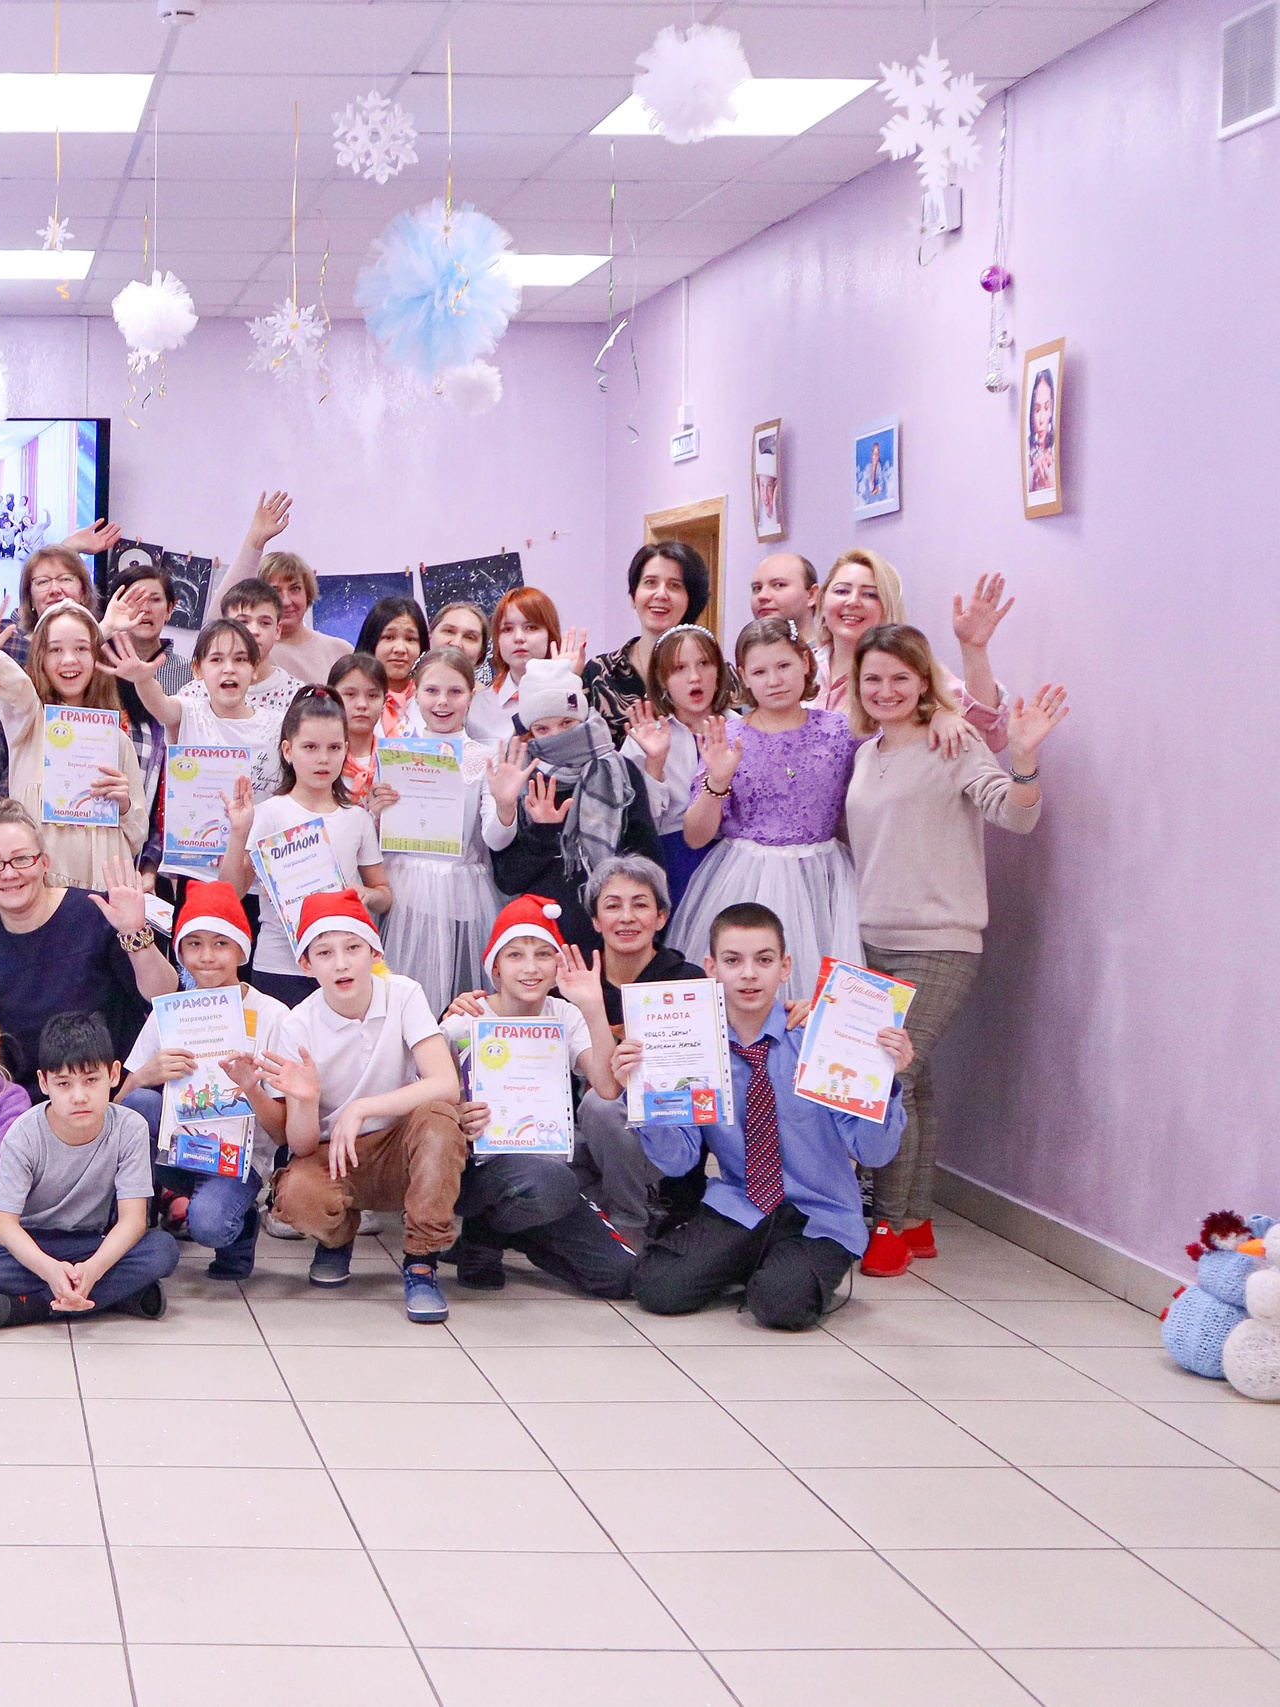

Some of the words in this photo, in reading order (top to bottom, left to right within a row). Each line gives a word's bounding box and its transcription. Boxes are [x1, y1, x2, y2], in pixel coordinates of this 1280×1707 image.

[60, 710, 115, 725] ГРАМОТА
[184, 748, 247, 759] ГРАМОТА
[401, 766, 441, 774] ГРАМОТА
[54, 808, 92, 818] молодец!
[178, 840, 219, 848] молодец!
[270, 833, 320, 860] ДИПЛОМ
[840, 976, 888, 1002] Грамота
[164, 994, 229, 1012] ГРАМОТА
[179, 1014, 223, 1023] Награждается
[646, 1012, 691, 1021] ГРАМОТА
[494, 1026, 560, 1039] ГРАМОТА
[188, 1037, 224, 1046] номинации
[489, 1138, 536, 1146] молодец!
